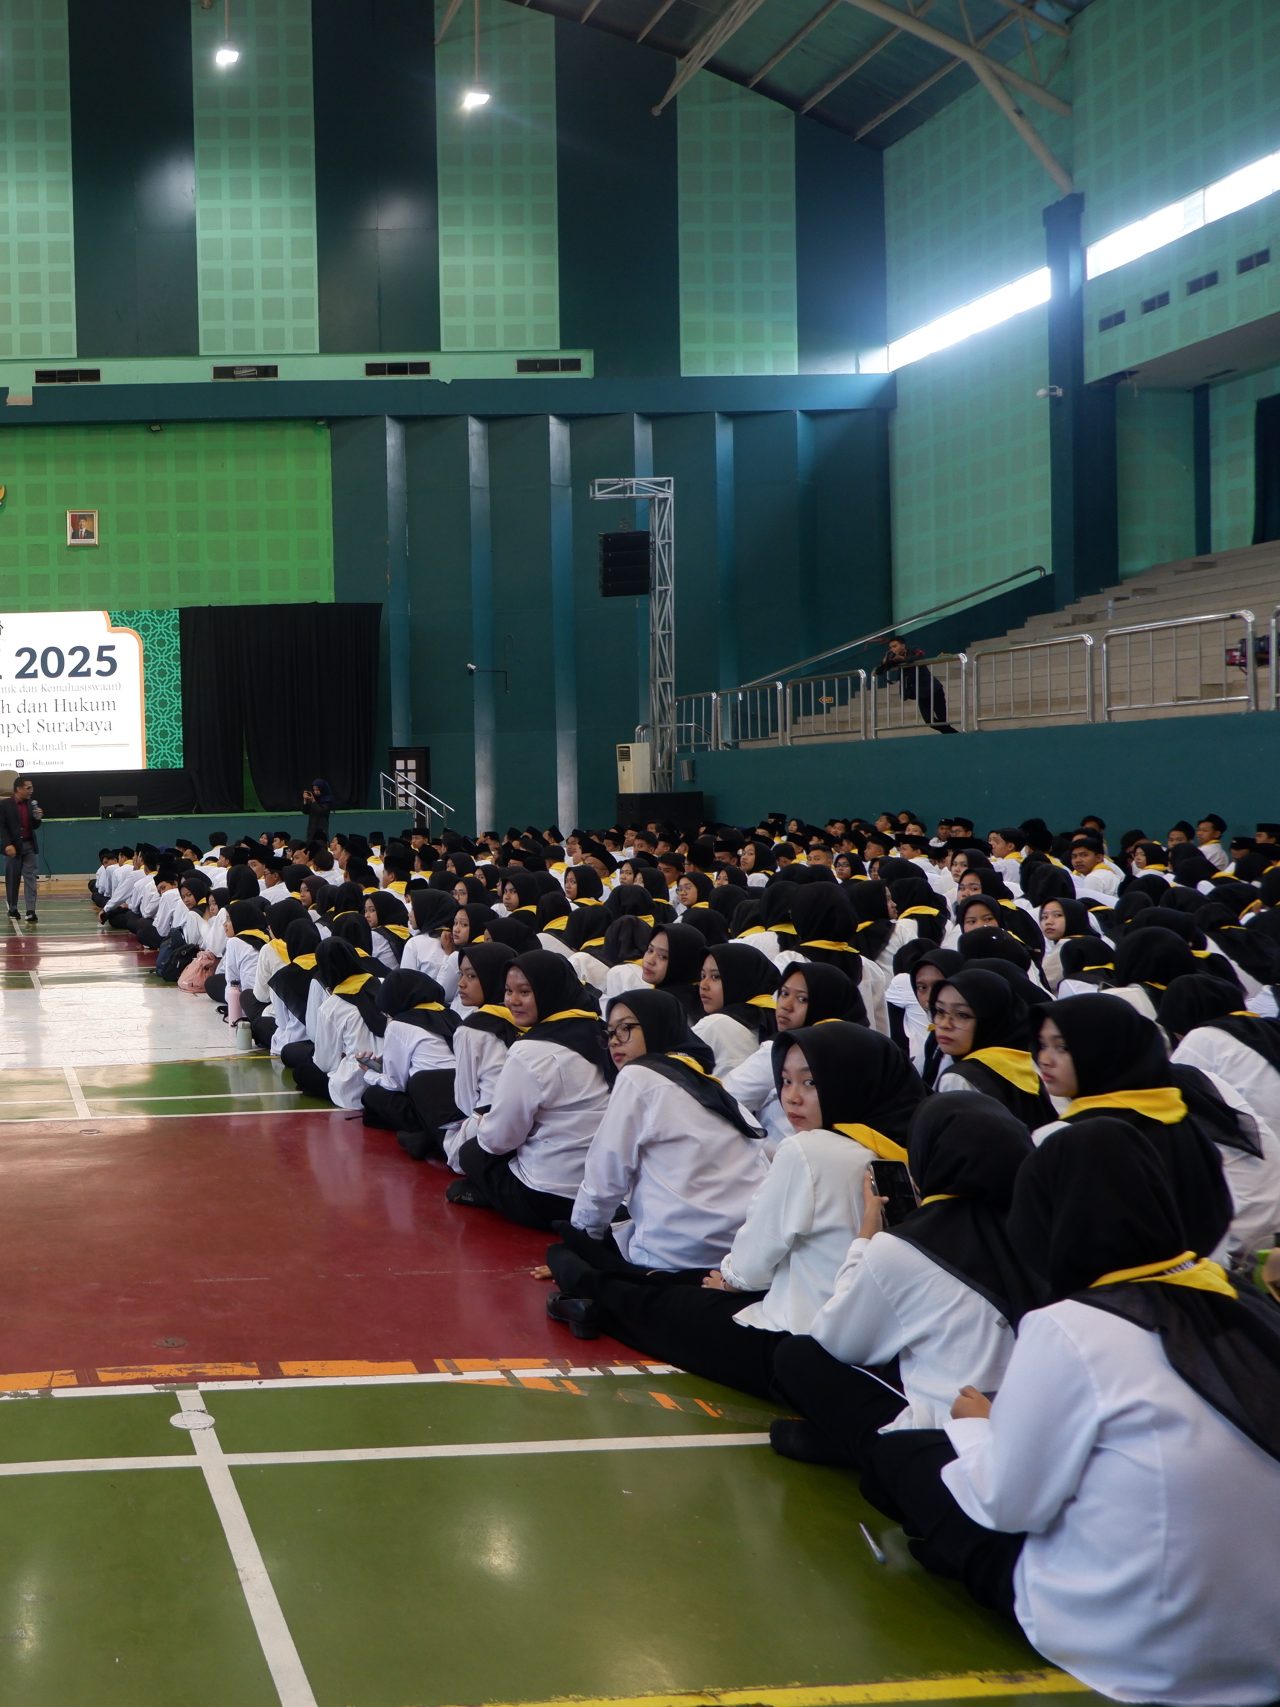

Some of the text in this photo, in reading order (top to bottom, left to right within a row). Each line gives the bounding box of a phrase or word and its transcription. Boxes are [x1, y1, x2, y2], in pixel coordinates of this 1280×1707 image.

[15, 645, 118, 679] 2025
[19, 684, 38, 694] dan
[16, 698, 48, 714] dan
[53, 697, 117, 712] Hukum
[36, 717, 113, 736] Surabaya
